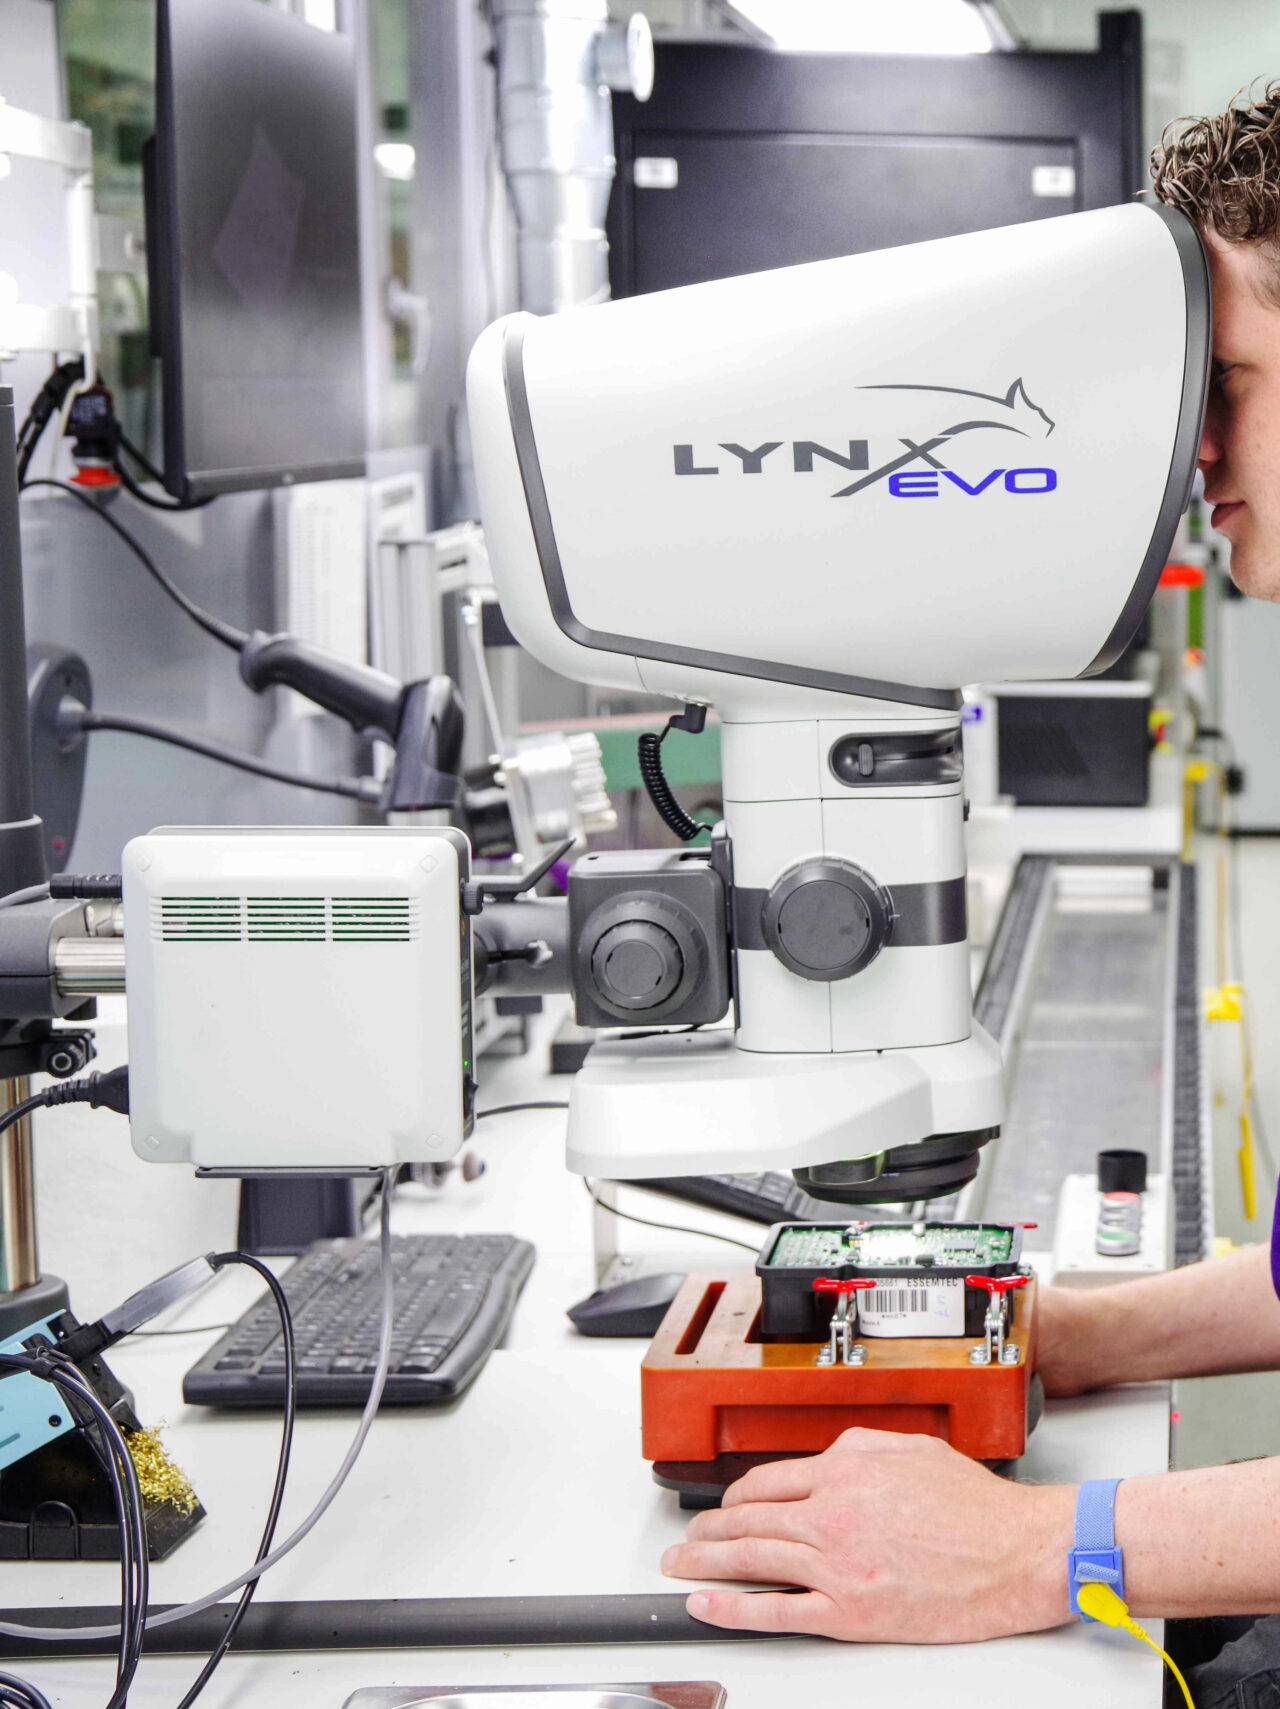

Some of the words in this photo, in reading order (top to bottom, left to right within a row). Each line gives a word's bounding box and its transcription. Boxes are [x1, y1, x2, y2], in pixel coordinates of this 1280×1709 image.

[673, 437, 953, 498] LYNX
[888, 467, 1058, 498] EVO
[907, 1278, 958, 1287] ESSEMTEC
